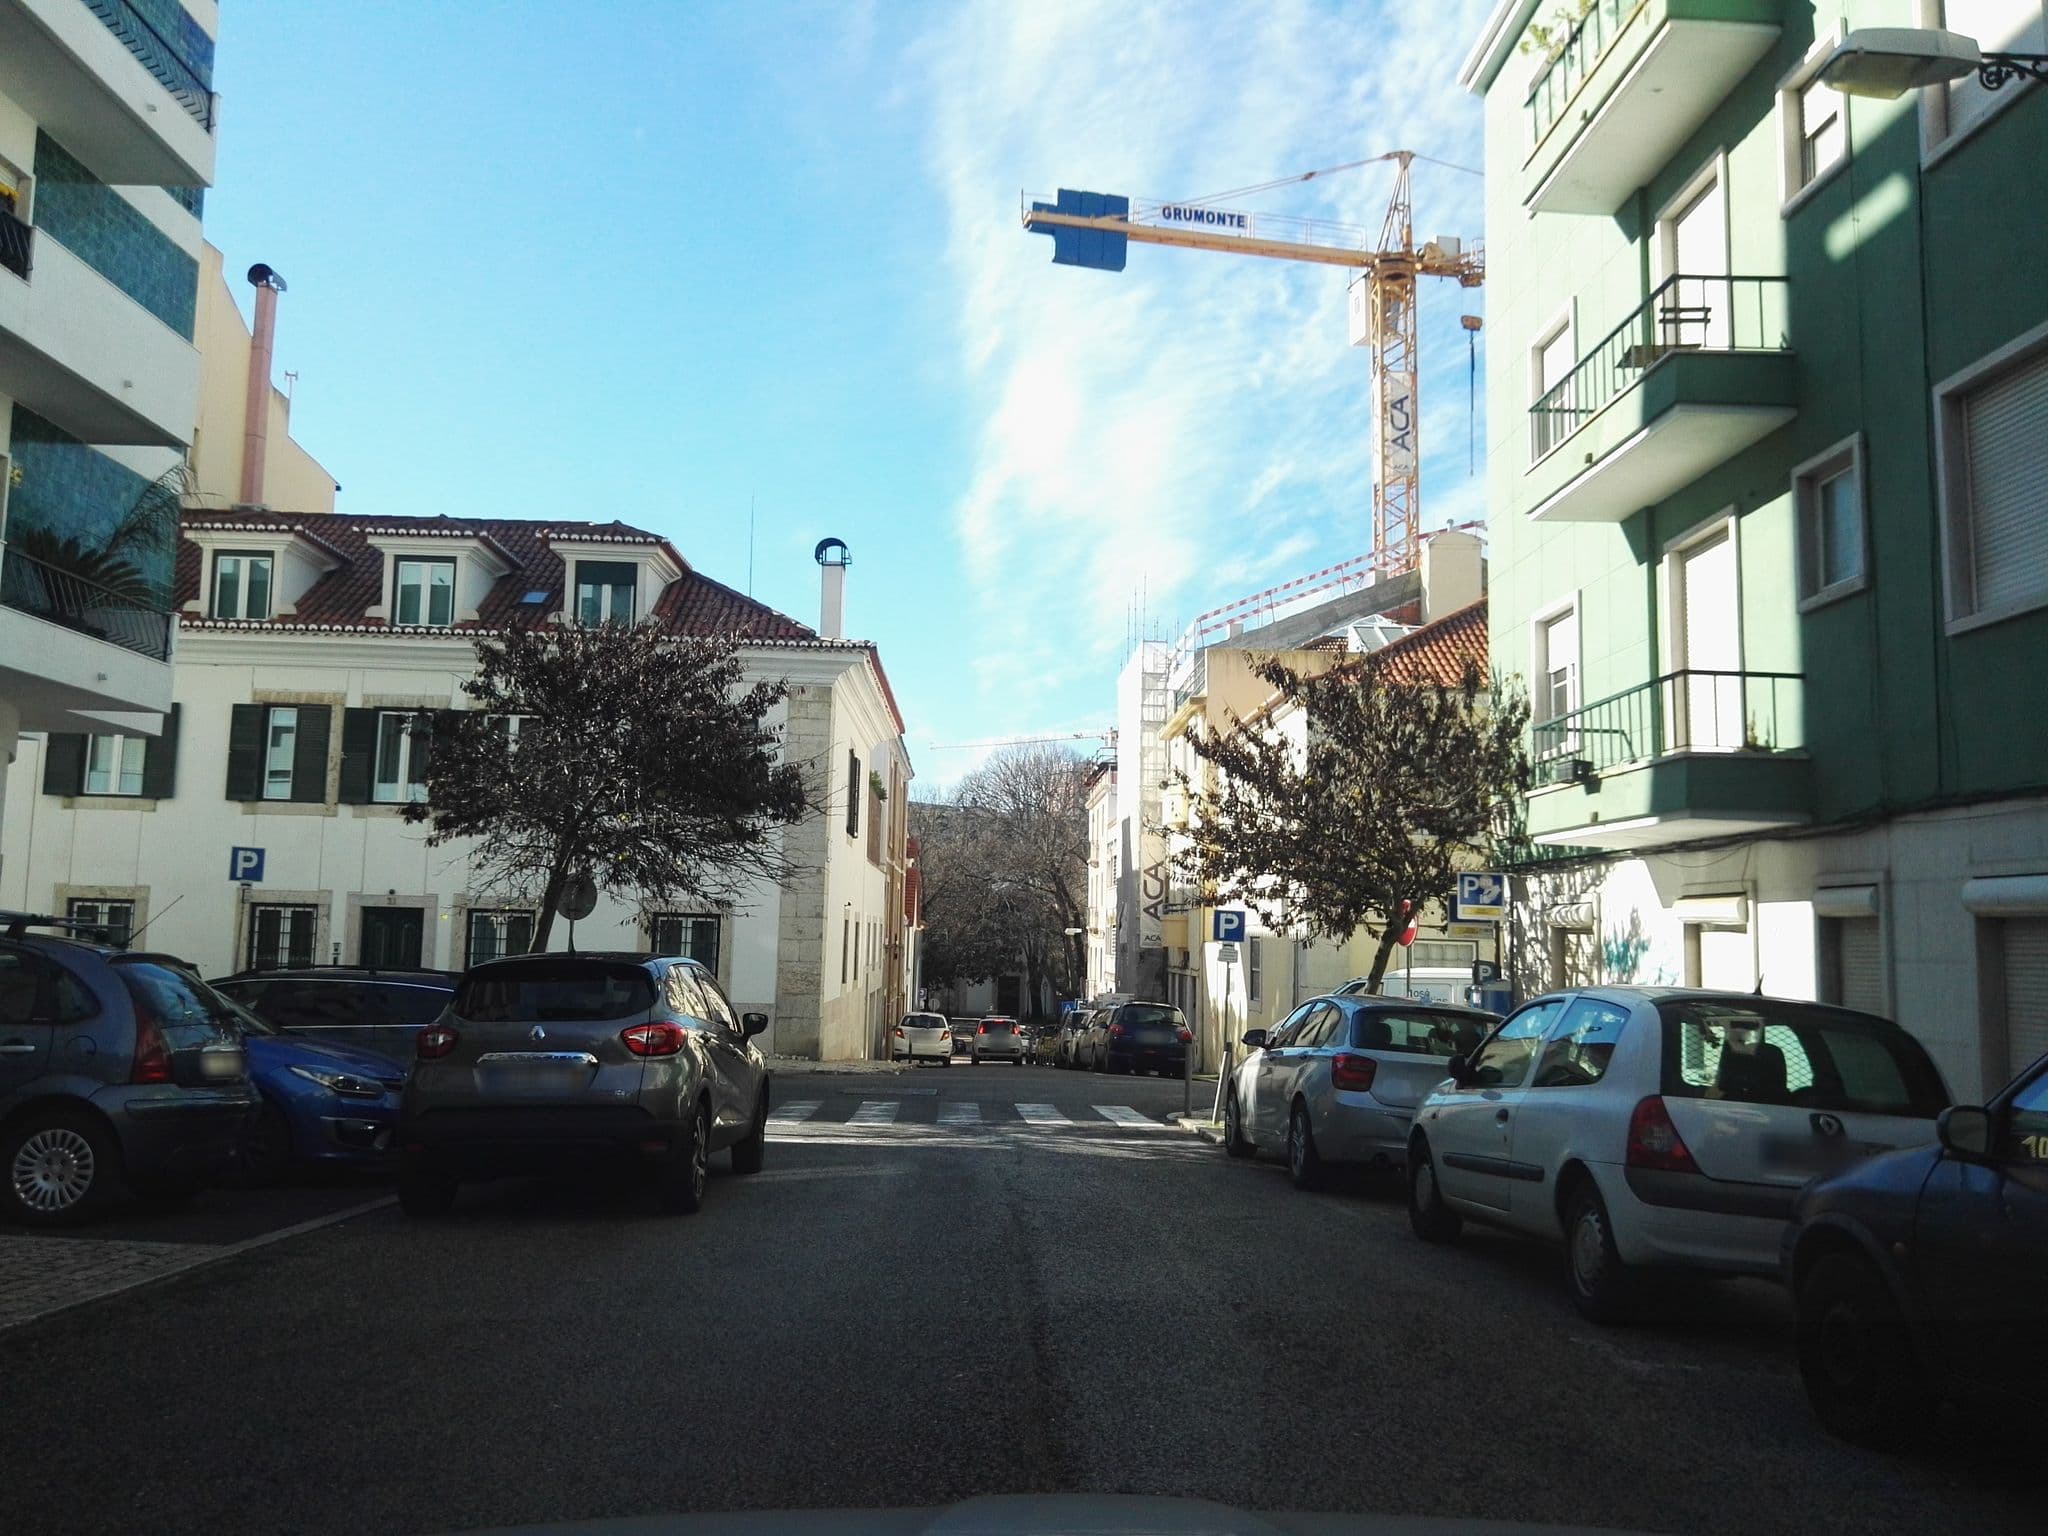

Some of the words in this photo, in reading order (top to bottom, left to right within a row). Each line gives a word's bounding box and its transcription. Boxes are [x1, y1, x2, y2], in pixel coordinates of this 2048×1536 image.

[1162, 206, 1245, 228] GRUMONTE
[1391, 395, 1410, 452] ACA
[237, 850, 258, 878] P
[1143, 861, 1164, 921] ACA
[1464, 876, 1479, 898] P
[1219, 913, 1239, 939] P
[1480, 965, 1492, 981] P
